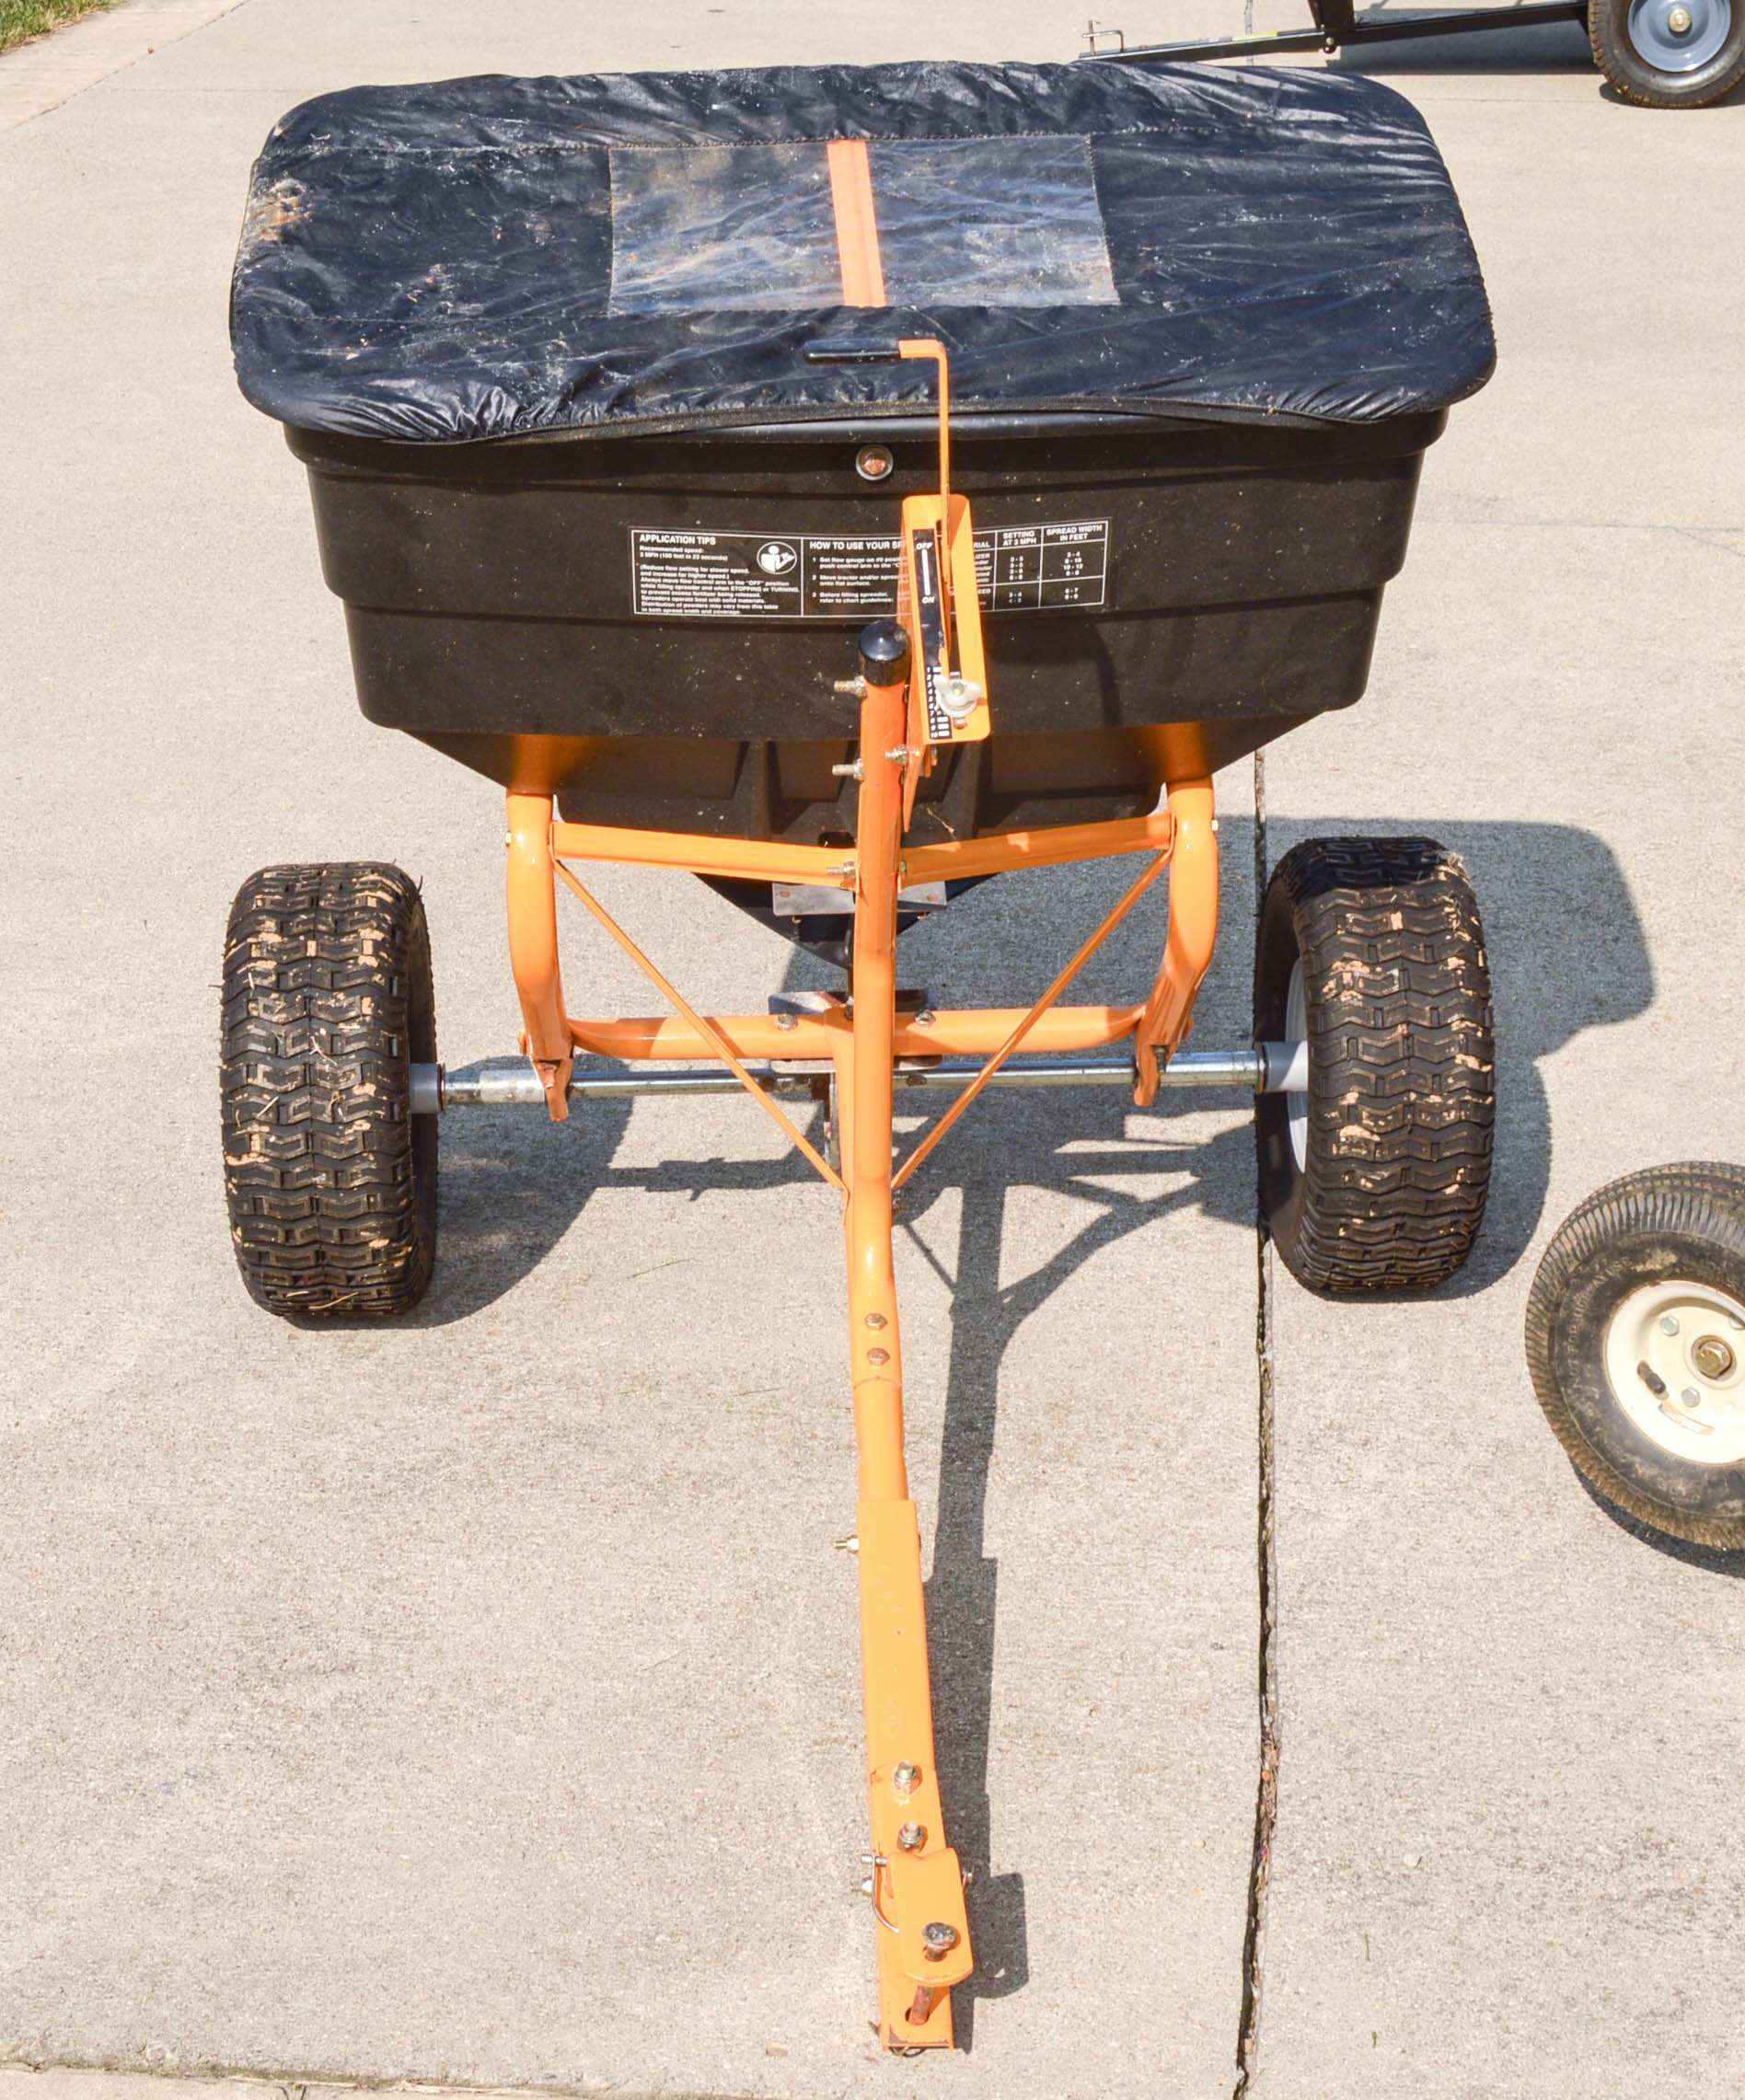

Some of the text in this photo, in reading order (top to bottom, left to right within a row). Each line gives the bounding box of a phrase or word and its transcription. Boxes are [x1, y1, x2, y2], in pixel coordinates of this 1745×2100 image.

[1003, 530, 1035, 539] SETTING
[1046, 525, 1103, 536] SPREAD WIDTH
[640, 534, 716, 545] APPLICATION TIPS
[1003, 538, 1013, 547] AT
[810, 541, 830, 549] HOW
[833, 541, 844, 549] TO
[866, 541, 890, 549] YOUR
[1568, 1325, 1581, 1355] FOR
